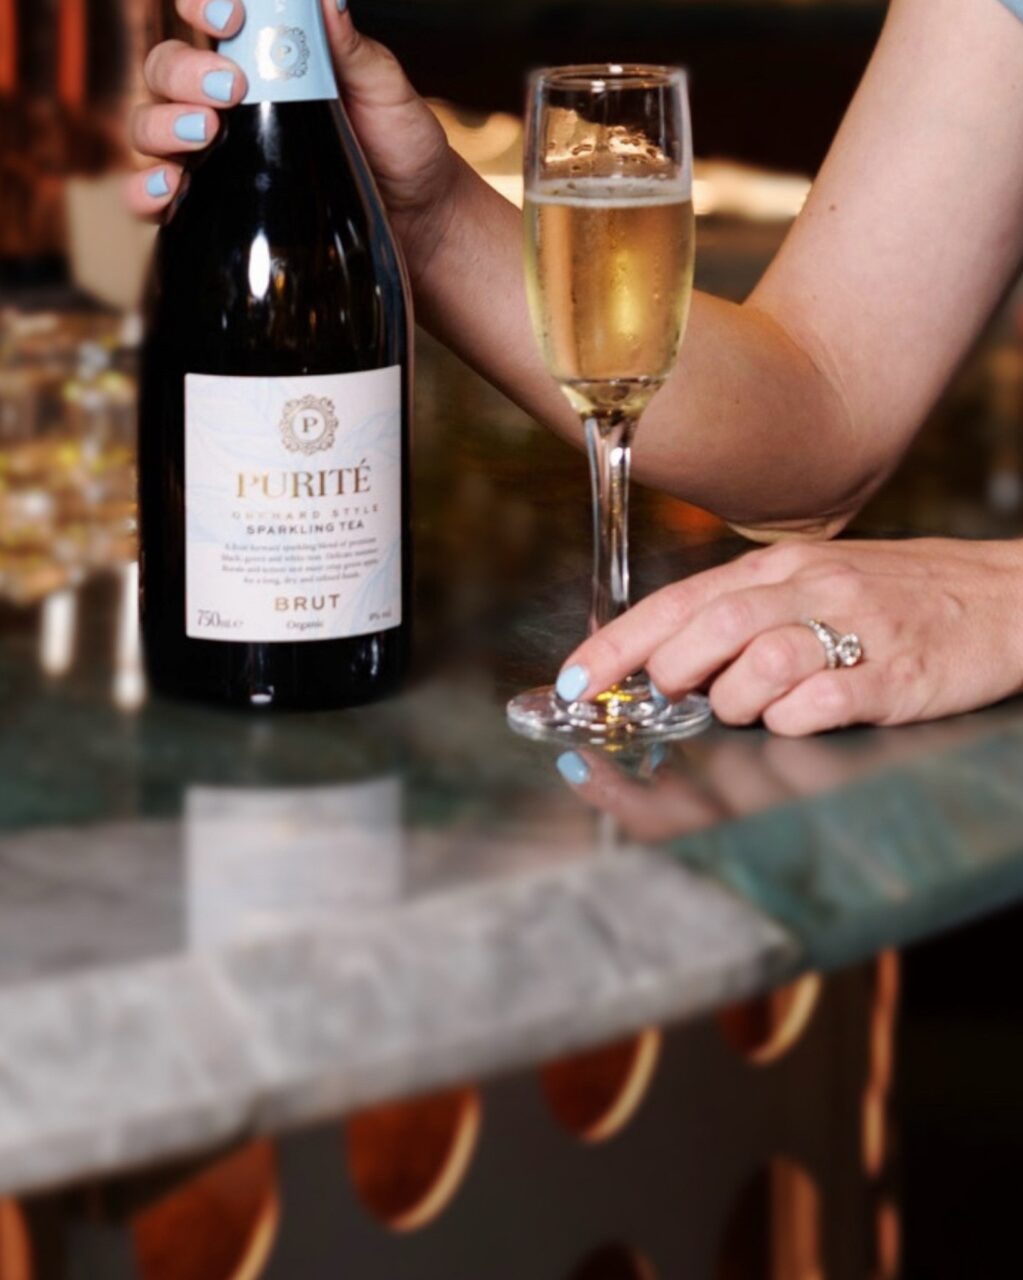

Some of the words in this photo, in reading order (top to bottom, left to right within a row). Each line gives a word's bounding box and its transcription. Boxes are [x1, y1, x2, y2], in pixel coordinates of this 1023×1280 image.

[302, 417, 318, 433] P
[236, 458, 372, 498] PURITÉ
[332, 503, 379, 518] STYLE
[246, 522, 335, 535] SPARKLING
[339, 519, 365, 531] TEA
[274, 593, 341, 612] BRUT
